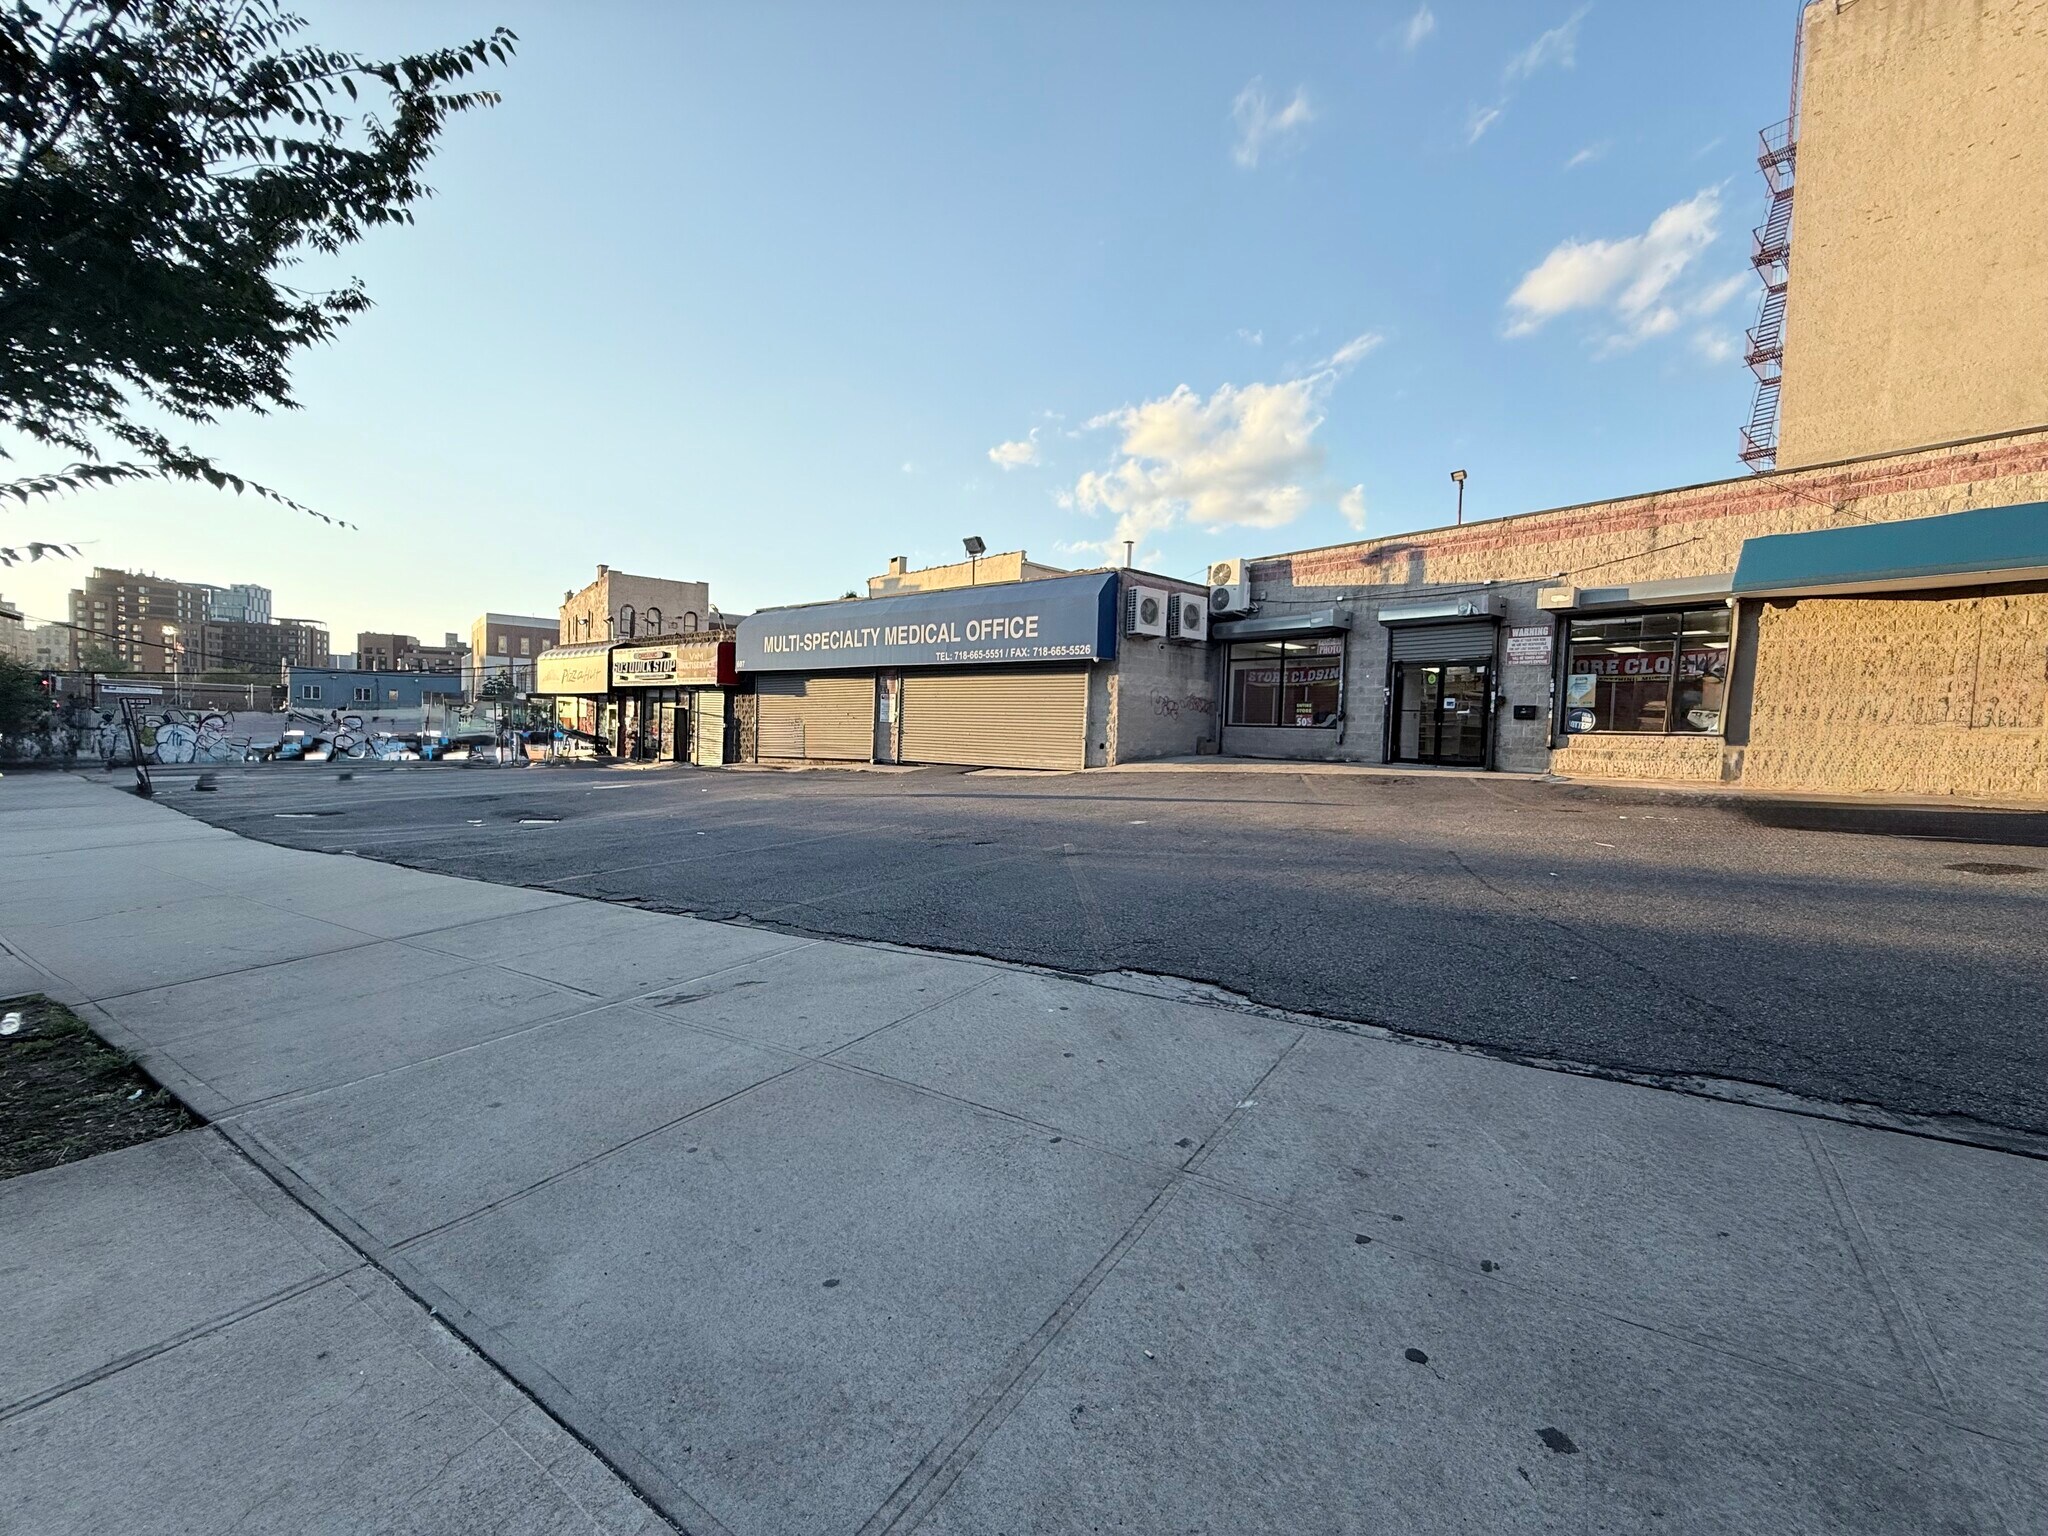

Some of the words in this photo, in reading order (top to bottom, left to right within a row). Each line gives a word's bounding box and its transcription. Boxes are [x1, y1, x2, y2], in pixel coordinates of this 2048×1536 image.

[763, 627, 881, 653] MULTI-SPECIALTY
[884, 622, 961, 646] MEDICAL
[966, 615, 1039, 641] OFFICE
[1512, 627, 1548, 637] WARNING
[936, 651, 953, 661] TEL:
[954, 649, 1003, 660] 718-665-5551
[1010, 647, 1030, 658] FAX:
[1033, 644, 1091, 657] 718-665-5526
[1319, 645, 1342, 654] PHOTO
[629, 661, 652, 673] QUICK
[653, 660, 677, 672] STOP
